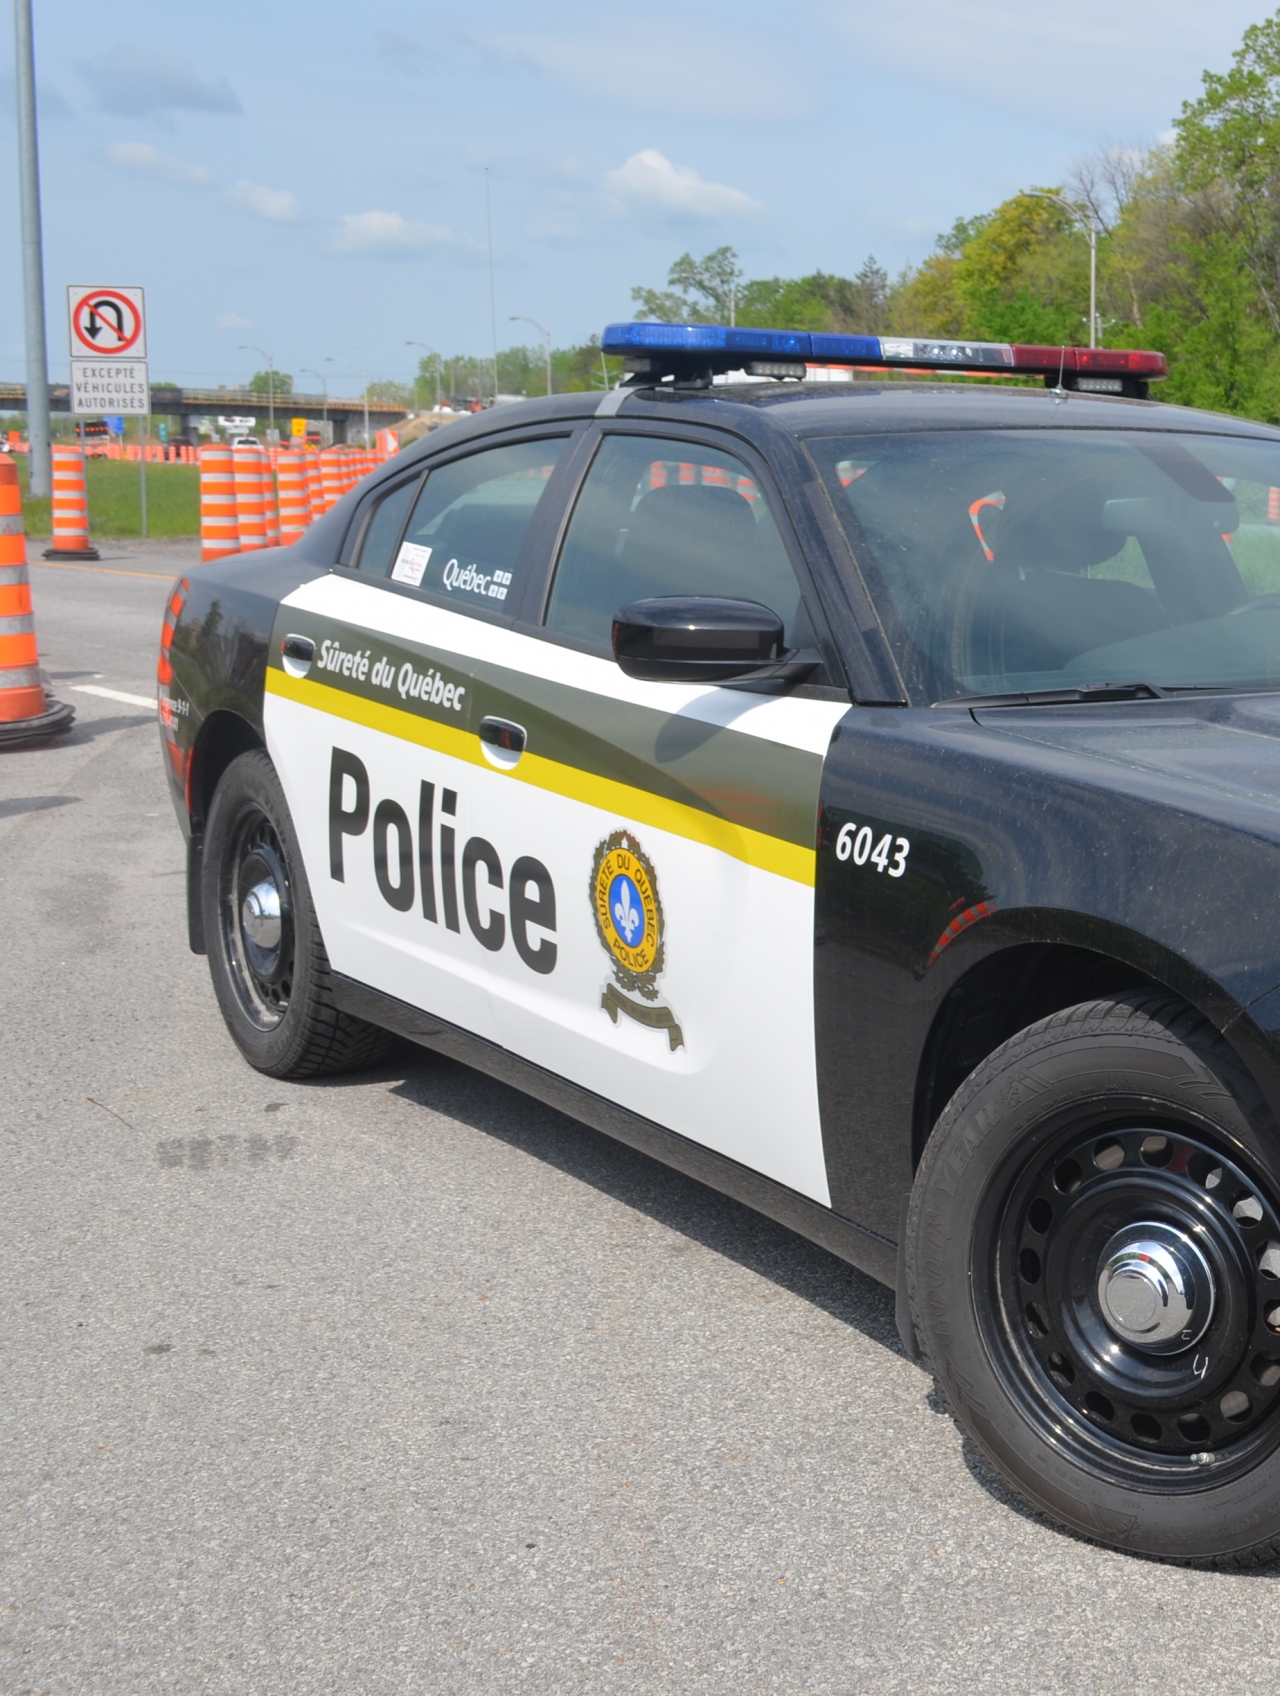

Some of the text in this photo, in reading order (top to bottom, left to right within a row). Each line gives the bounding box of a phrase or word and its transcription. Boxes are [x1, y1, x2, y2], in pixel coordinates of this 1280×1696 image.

[75, 380, 145, 394] VÉHICULES
[82, 366, 136, 379] EXCEPTÉ
[78, 396, 145, 408] AUTORISÉS
[443, 558, 491, 595] Québec
[317, 639, 465, 711] Sûreté du Québec
[329, 746, 558, 975] Police
[616, 853, 630, 871] DU
[836, 822, 910, 878] 6043
[613, 938, 649, 968] POLICE
